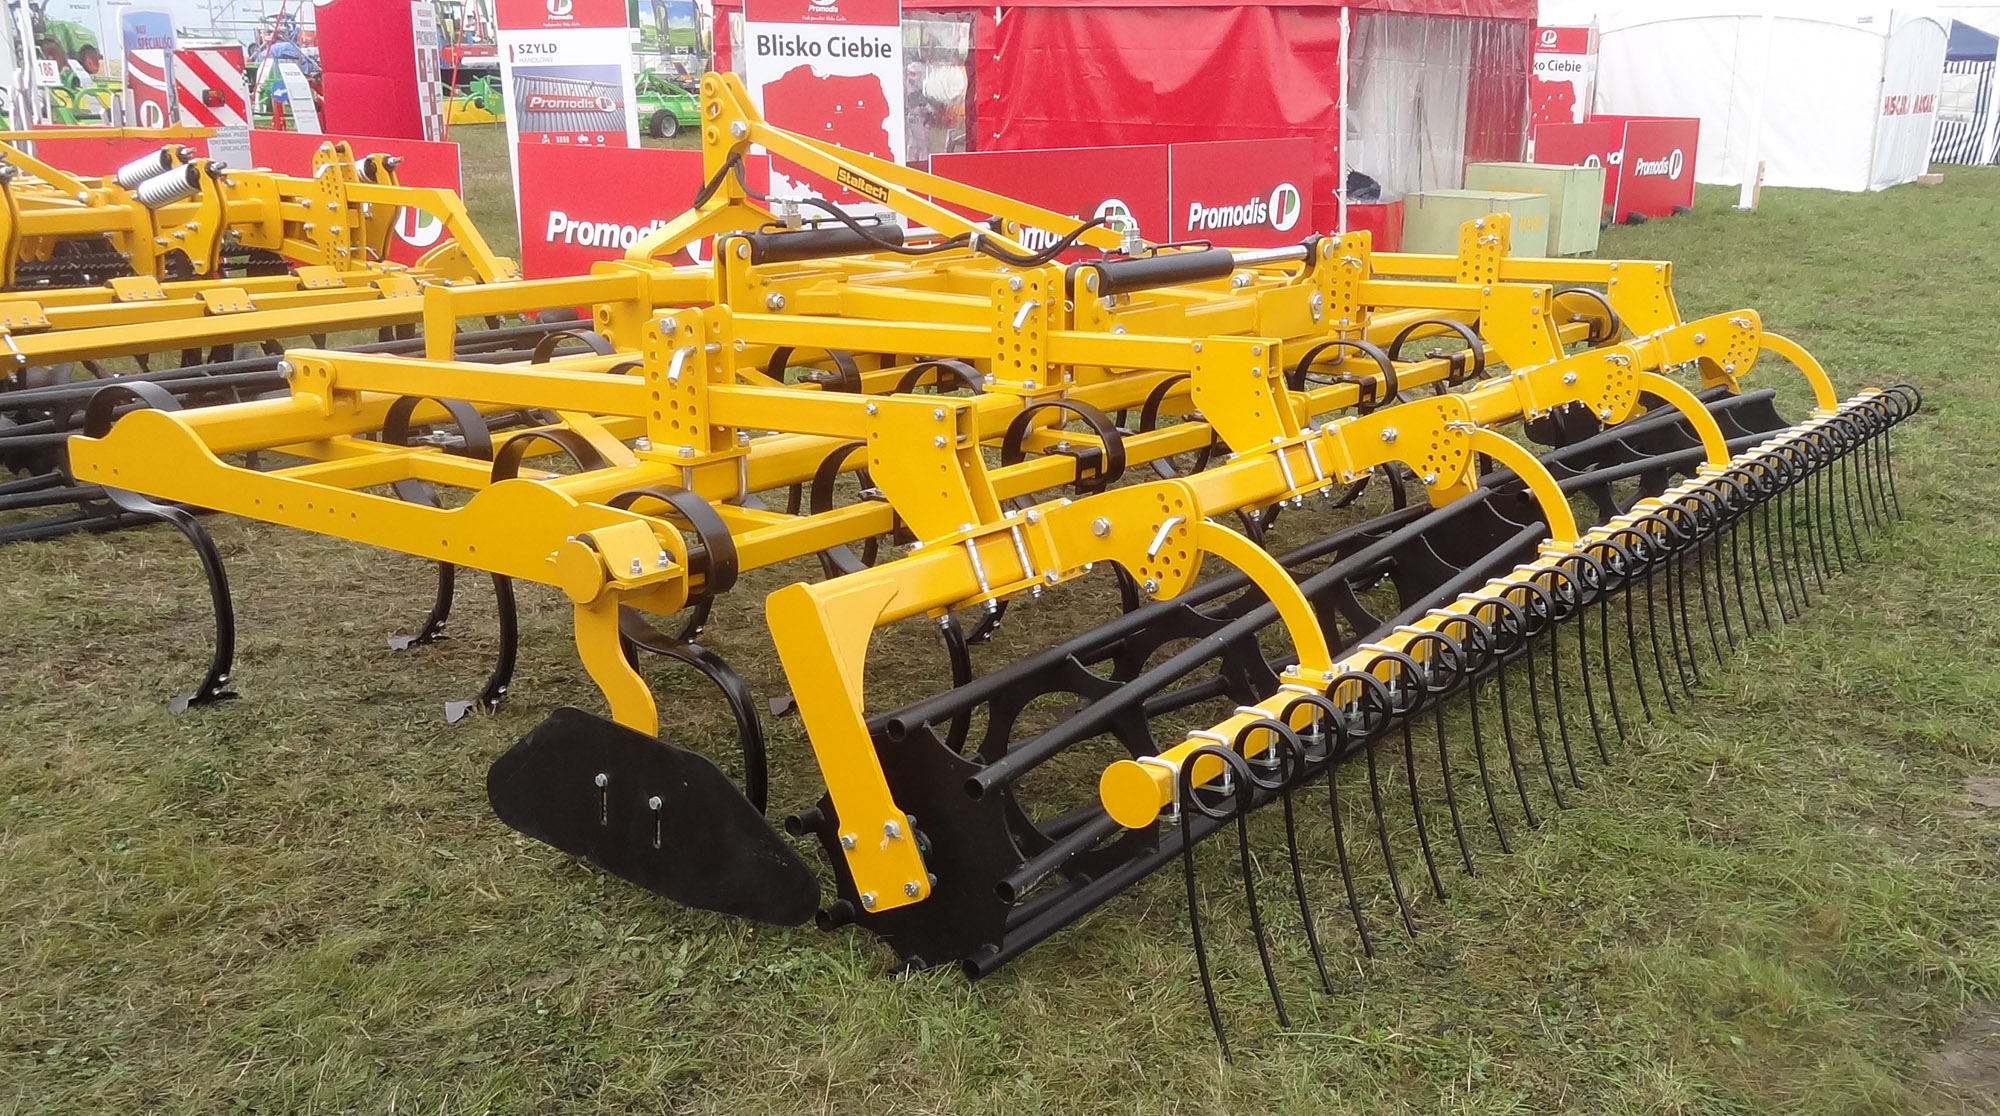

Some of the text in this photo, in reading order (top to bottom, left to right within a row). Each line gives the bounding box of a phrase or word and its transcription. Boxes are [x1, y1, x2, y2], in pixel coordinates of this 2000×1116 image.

[808, 5, 839, 13] Promodis
[518, 43, 557, 54] SZYLD
[757, 34, 892, 58] Blisko Ciebie
[38, 62, 54, 77] 186
[1548, 60, 1582, 72] Ciebie
[529, 97, 595, 109] Promodis
[1635, 157, 1669, 176] Promodis
[838, 168, 888, 202] Staltech
[1187, 197, 1267, 232] Promodis
[546, 211, 666, 250] Promod
